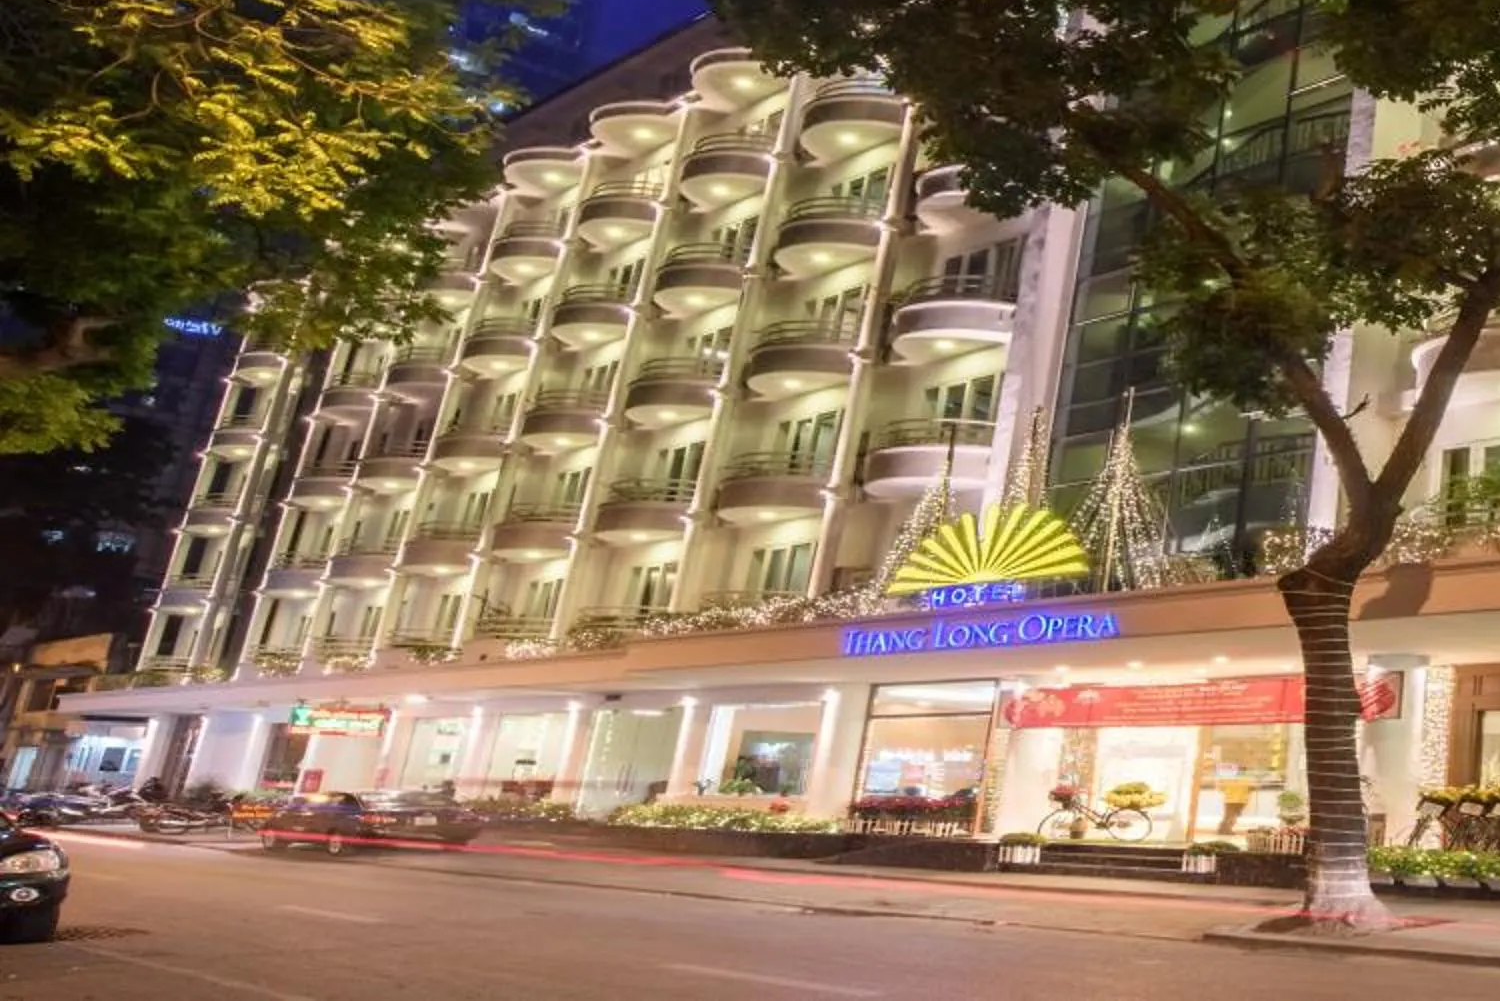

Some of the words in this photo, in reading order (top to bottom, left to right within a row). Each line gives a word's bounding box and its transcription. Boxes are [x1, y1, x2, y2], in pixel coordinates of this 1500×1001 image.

[845, 630, 926, 655] THANG
[934, 623, 1008, 648] LONG
[1018, 613, 1115, 641] OPERA
